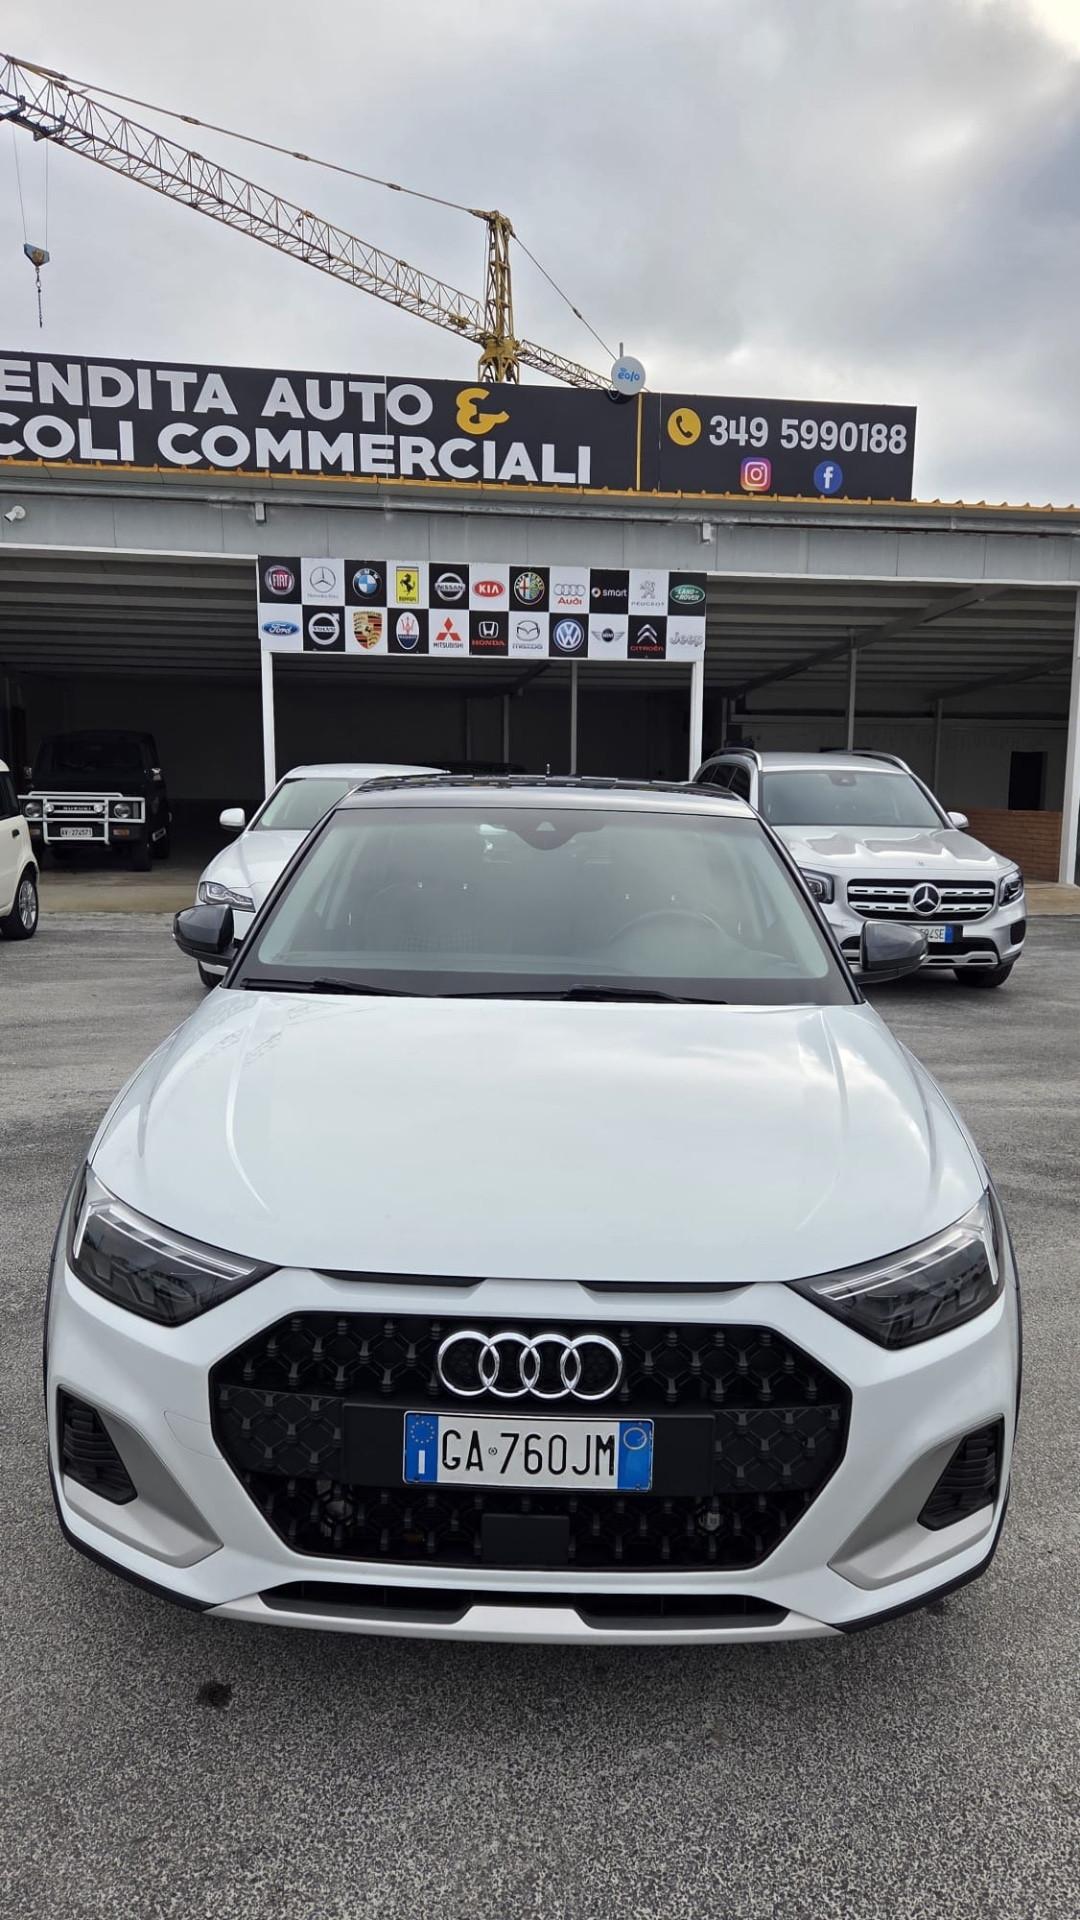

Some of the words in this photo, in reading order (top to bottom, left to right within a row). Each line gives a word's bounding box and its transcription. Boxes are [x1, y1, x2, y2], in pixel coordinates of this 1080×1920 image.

[617, 370, 640, 382] eolo
[0, 358, 238, 415] ENDITA
[261, 377, 434, 426] AUTO
[456, 387, 510, 435] &
[709, 415, 768, 448] 349
[780, 418, 908, 454] 5990188
[157, 422, 591, 485] COMMERCIALI
[272, 574, 289, 588] FIAT
[479, 585, 500, 594] KIA
[602, 588, 628, 597] smart
[557, 597, 582, 606] Audi
[269, 623, 293, 634] Ford
